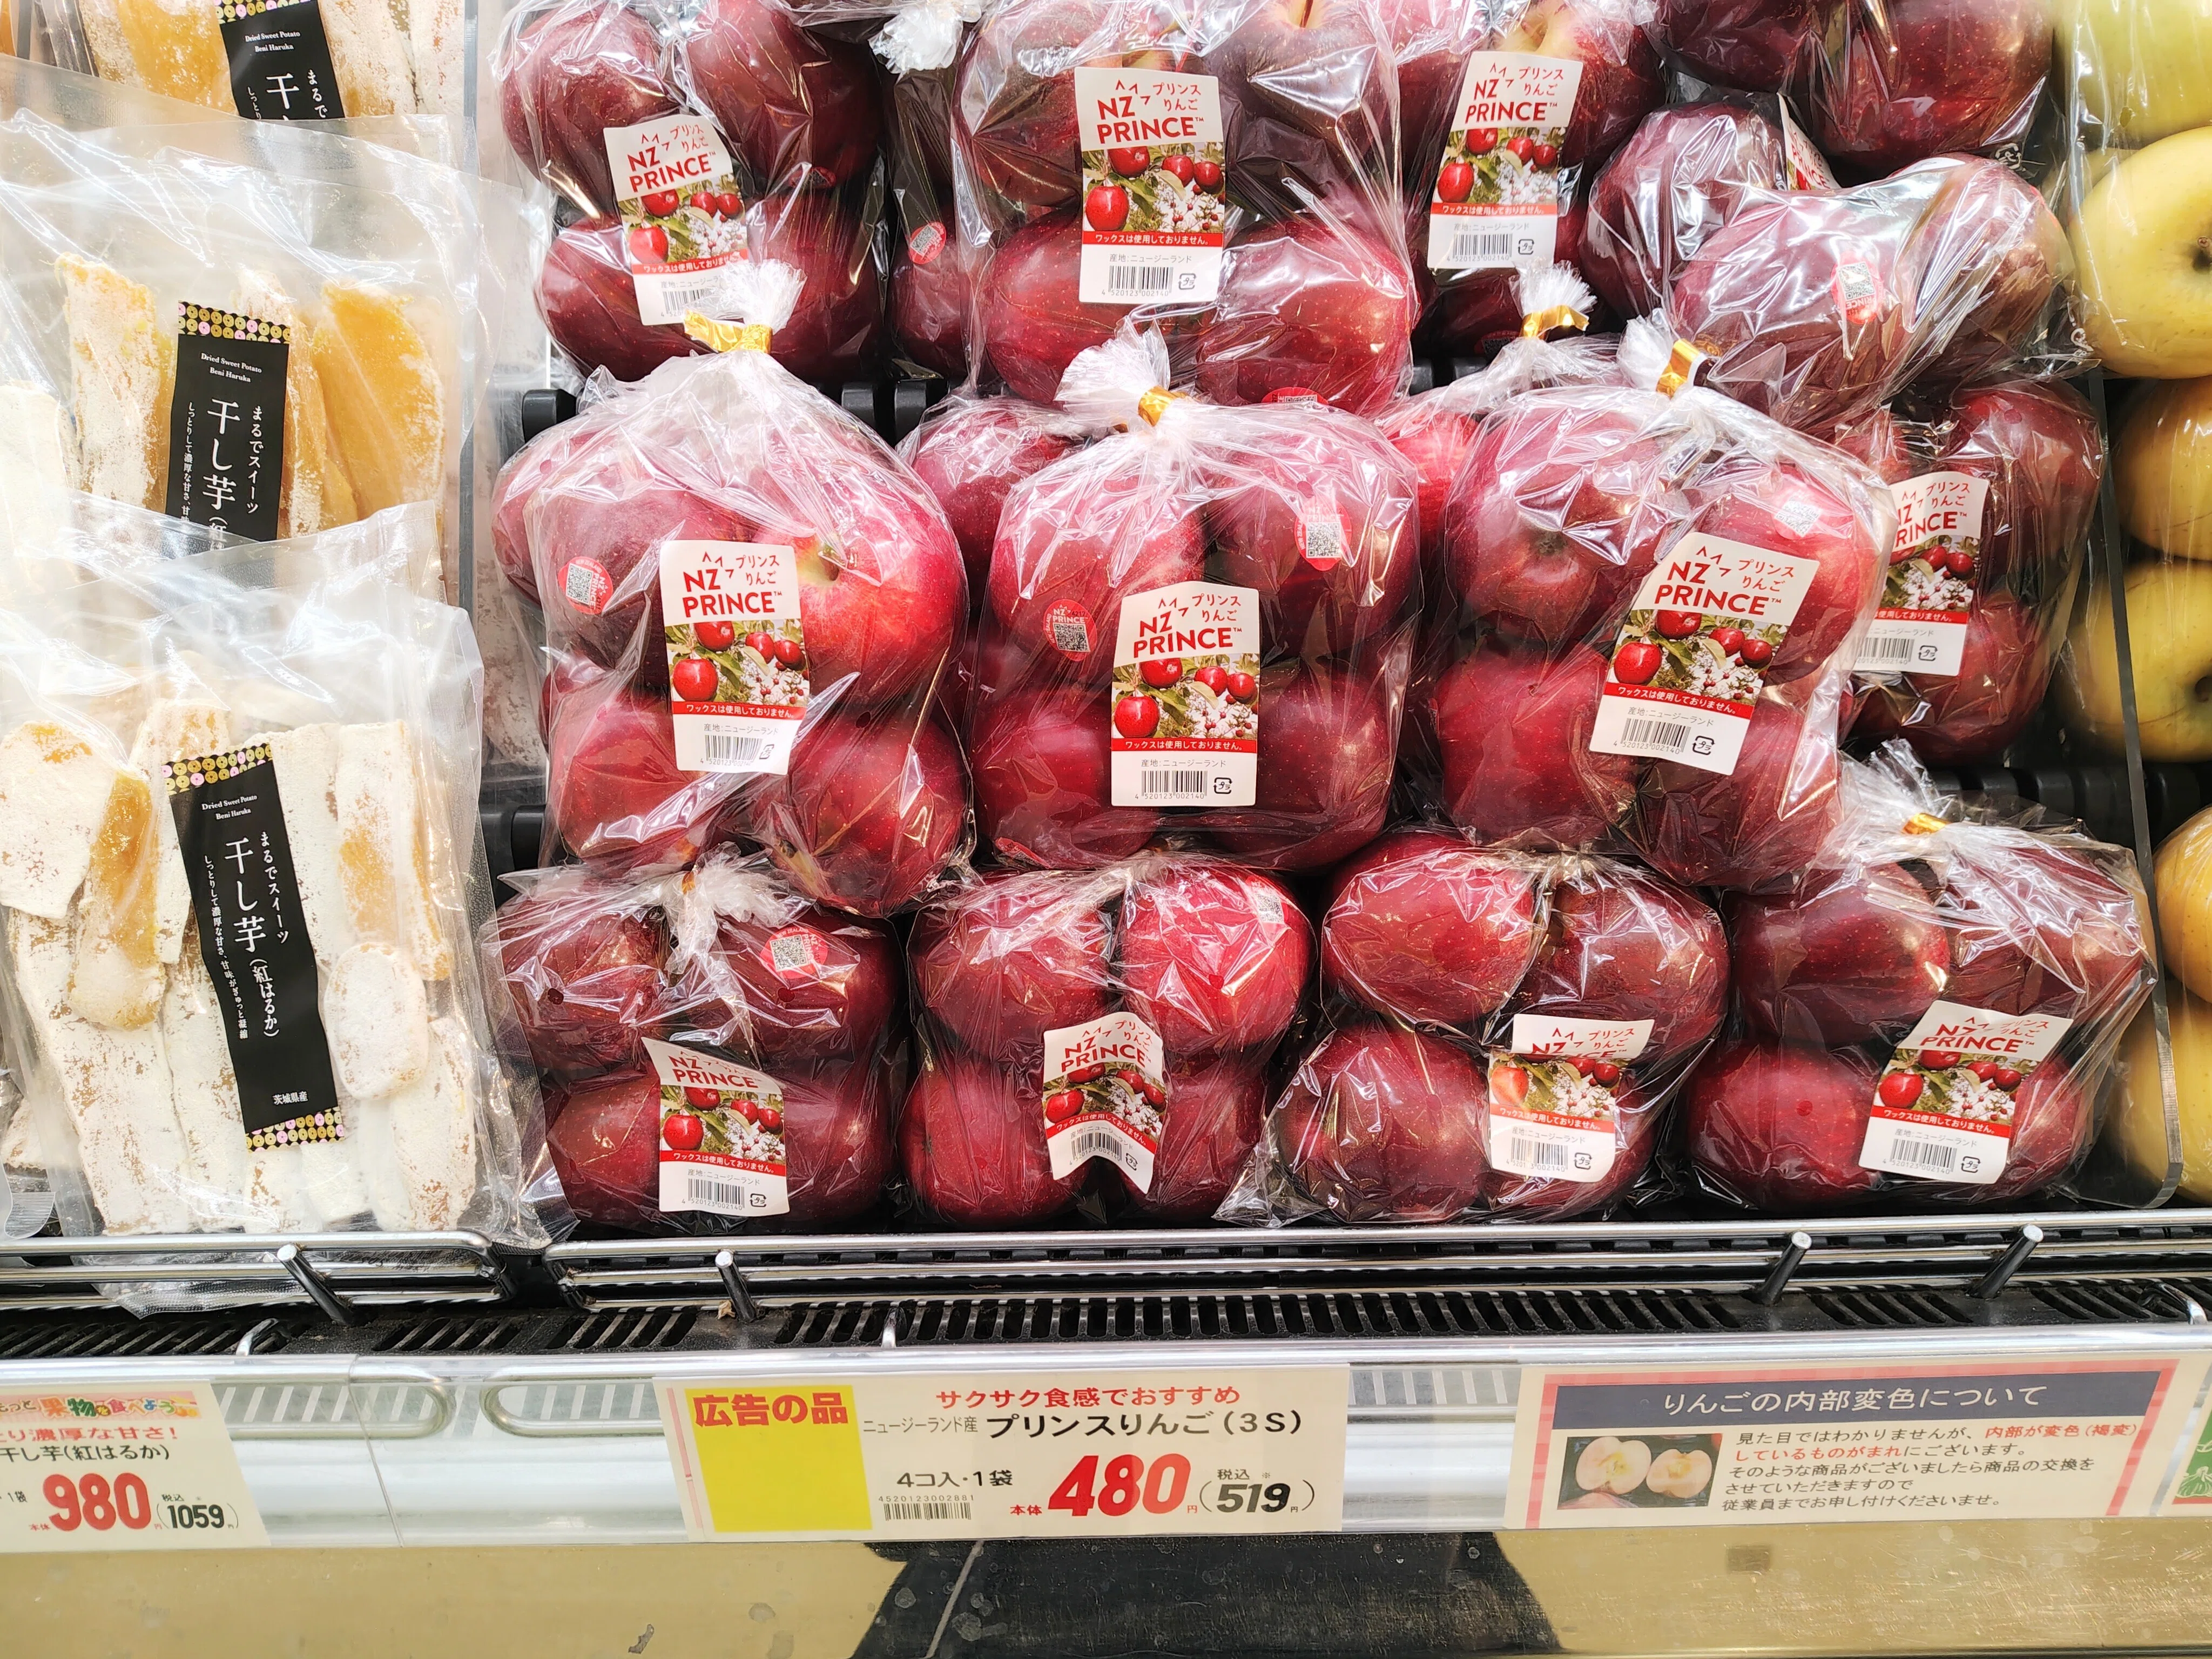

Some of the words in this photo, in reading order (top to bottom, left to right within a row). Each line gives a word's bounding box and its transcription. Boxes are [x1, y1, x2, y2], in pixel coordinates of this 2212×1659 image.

[1519, 68, 1564, 80] プリンス
[266, 73, 300, 120] 干
[1153, 83, 1202, 96] プリンス
[1473, 78, 1498, 100] NZ
[1523, 84, 1558, 96] りんご
[1097, 96, 1136, 120] NZ
[1164, 98, 1198, 111] りんご
[682, 137, 709, 153] りんご
[628, 146, 660, 172] NZ
[201, 352, 220, 364] Dried
[220, 357, 240, 369] Sweet
[241, 361, 262, 374] Potato
[210, 366, 225, 376] Beni
[226, 370, 251, 382] Haruka
[246, 405, 264, 515] まるでスイーツ
[1926, 482, 1970, 497] プリンス
[1931, 495, 1966, 509] りんご
[736, 554, 780, 569] プリンス
[1738, 558, 1795, 578] プリンス
[683, 569, 721, 592] NZ
[746, 570, 777, 585] りんご
[1667, 561, 1712, 584] NZ
[1742, 575, 1786, 592] りんご
[1192, 594, 1242, 607] プリンス
[1139, 608, 1172, 637] NZ
[1202, 610, 1238, 623] りんご
[201, 800, 222, 811] Dried
[224, 798, 240, 807] Sweet
[240, 794, 258, 804] Potato
[215, 811, 230, 820] Beni
[231, 807, 252, 818] Haruka
[259, 831, 291, 946] まるでスイーツ
[1589, 1028, 1635, 1041] プリンス
[1936, 1023, 1977, 1036] NZ
[1065, 1036, 1097, 1058] NZ
[1124, 1031, 1150, 1052] りんご
[1594, 1038, 1629, 1050] りんご
[669, 1055, 703, 1069] NZ
[273, 1091, 309, 1106] 茨城県産
[936, 1387, 1240, 1408] サクサク食感でおすすめ
[1665, 1385, 2048, 1415] りんごの内部変色について
[693, 1392, 848, 1427] 広告の品
[864, 1416, 978, 1434] ニュージーランド産
[1217, 1468, 1250, 1480] 税込
[1729, 1458, 2095, 1478] そのような商品がございましたら商品の交換を
[1010, 1505, 1042, 1515] 本体
[1048, 1453, 1191, 1516] 480
[1725, 1479, 1913, 1495] させていただきますので
[43, 1473, 152, 1532] 980
